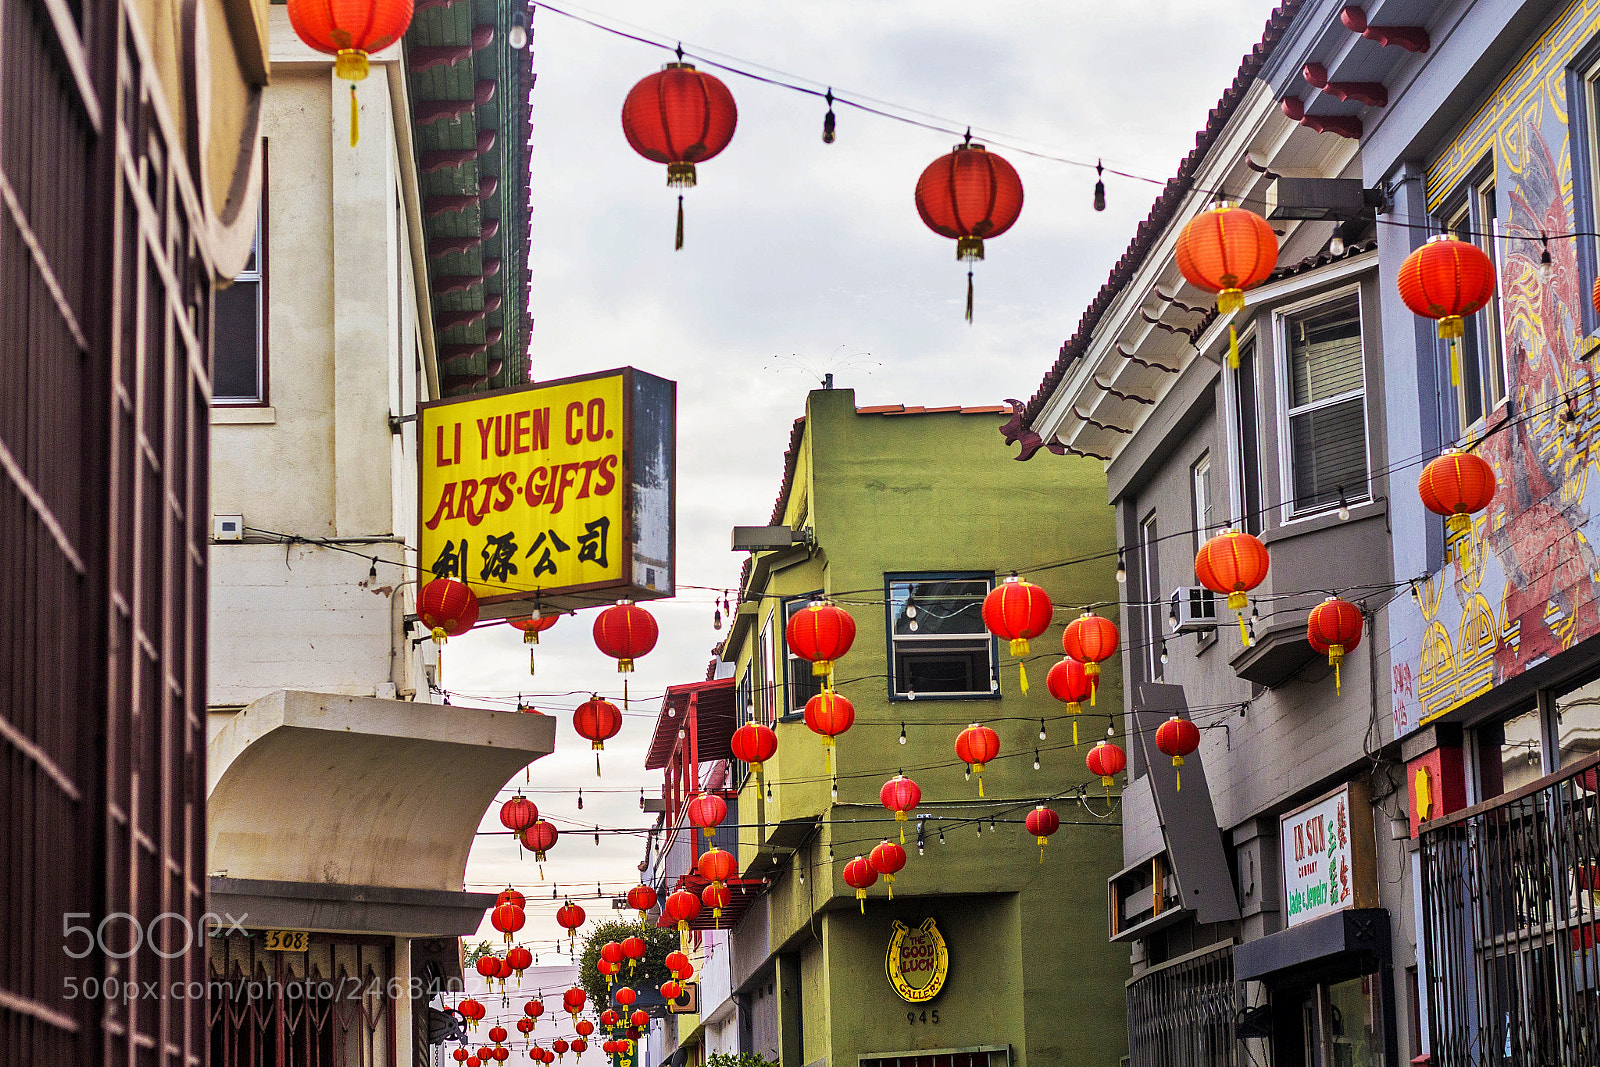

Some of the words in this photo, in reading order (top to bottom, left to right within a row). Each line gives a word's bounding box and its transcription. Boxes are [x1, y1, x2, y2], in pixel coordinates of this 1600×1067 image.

[436, 422, 462, 468] LI
[477, 406, 550, 460] YUEN
[565, 397, 614, 446] CO.
[431, 517, 611, 584] 利源公司
[1294, 823, 1305, 862] IN
[1306, 814, 1325, 857] SUN
[1306, 879, 1327, 911] Jewelry
[268, 931, 304, 950] 508
[909, 936, 926, 945] THE
[902, 946, 934, 958] GOOD
[902, 958, 934, 972] LUCK
[899, 977, 941, 999] GALLERY
[906, 1009, 940, 1026] 945
